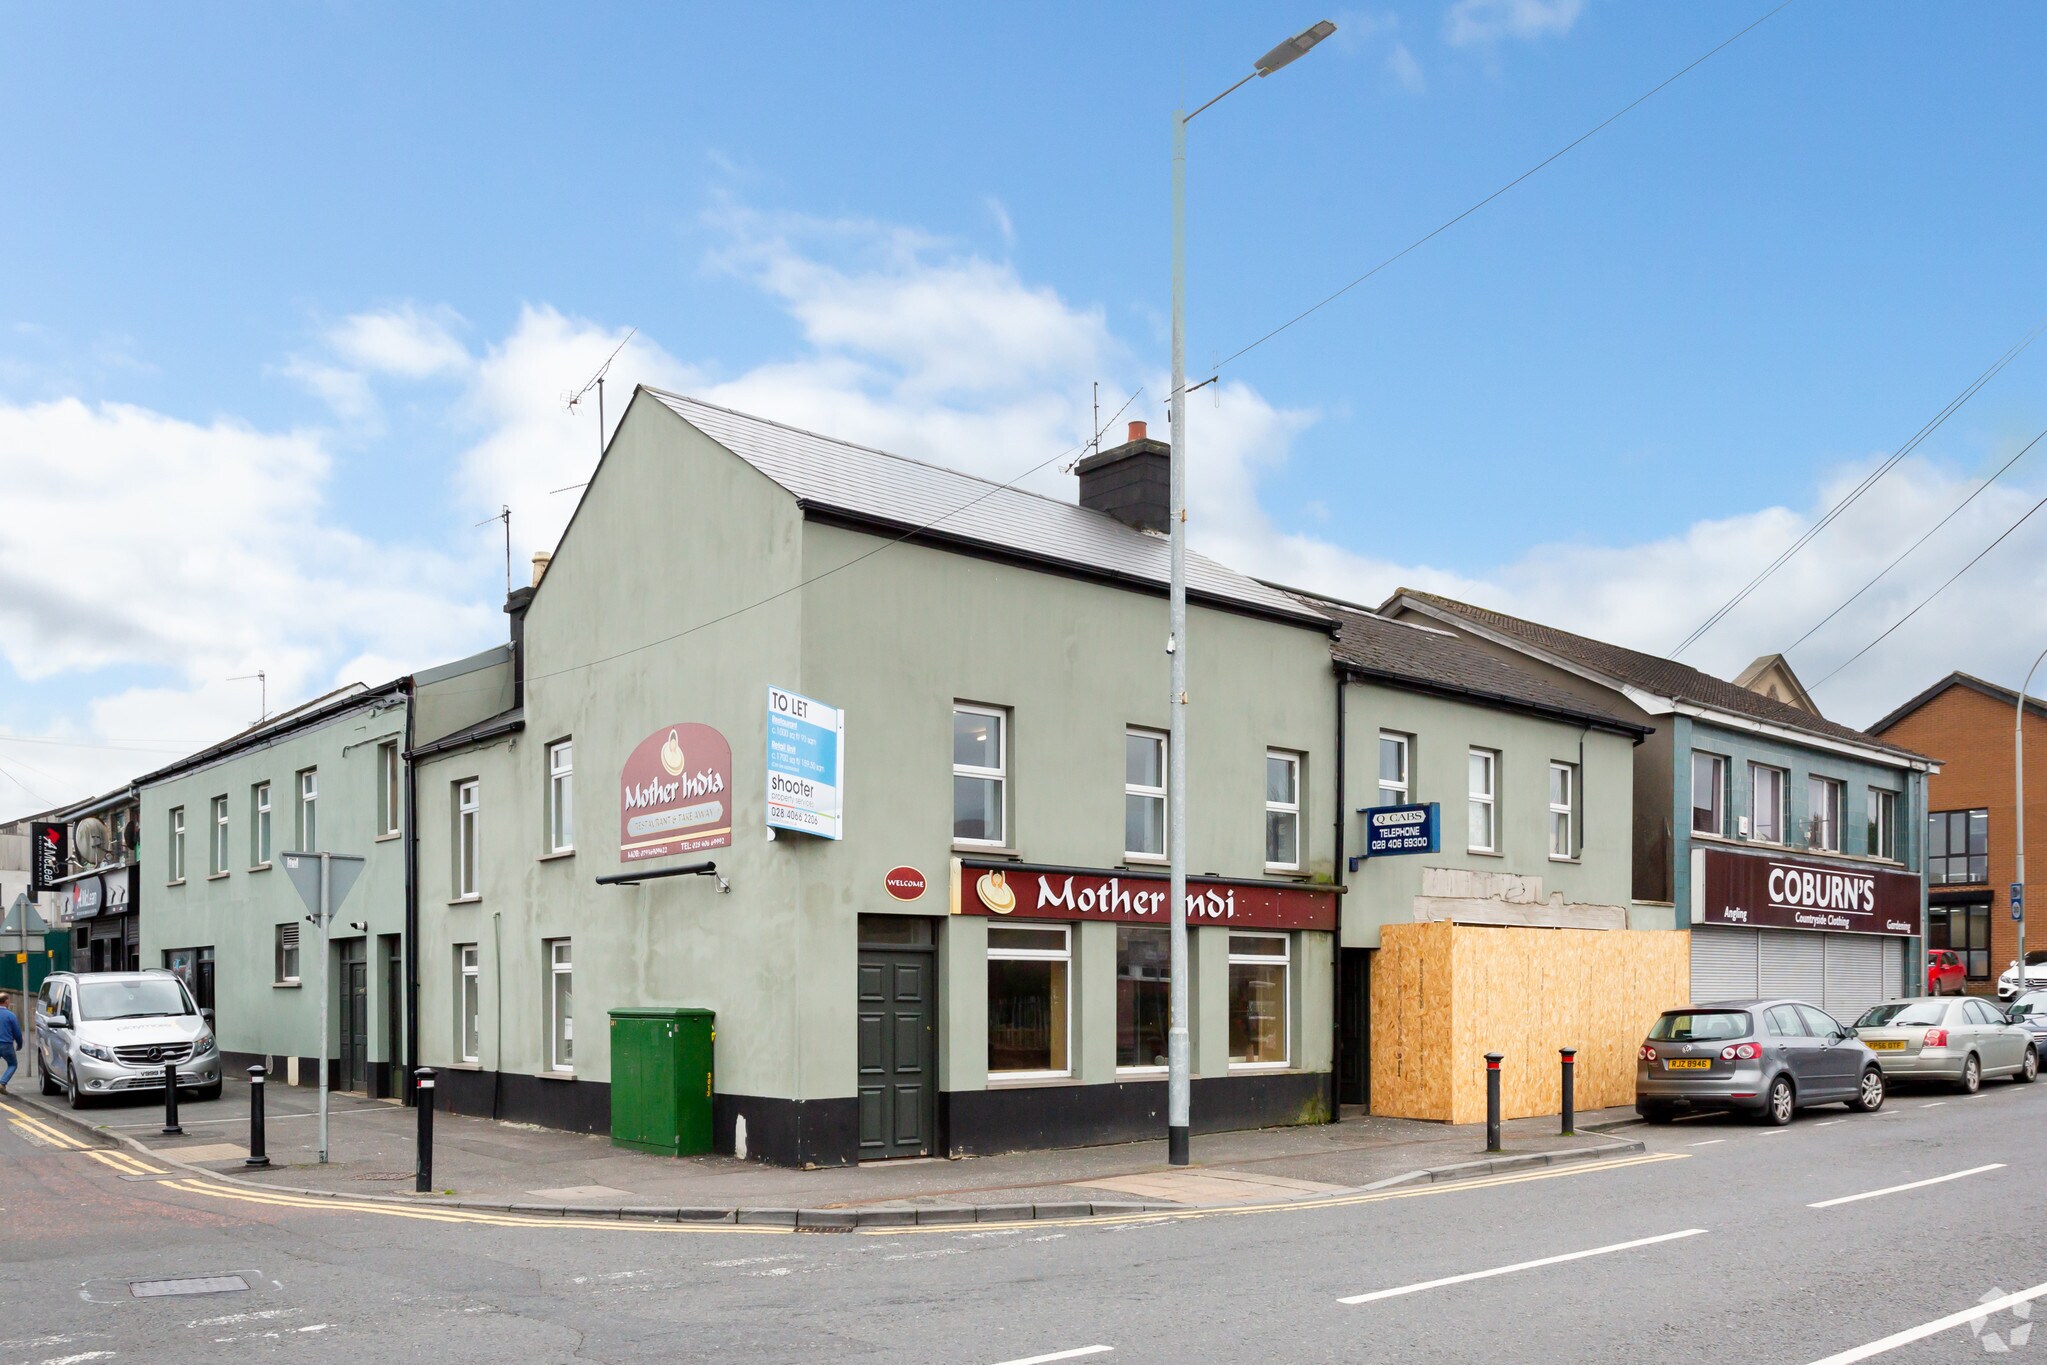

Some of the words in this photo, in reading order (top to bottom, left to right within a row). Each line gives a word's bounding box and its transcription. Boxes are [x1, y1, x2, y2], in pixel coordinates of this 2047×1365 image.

[772, 692, 788, 712] TO
[792, 698, 808, 718] LET
[625, 776, 680, 811] Mother
[682, 768, 725, 800] India
[772, 774, 814, 798] shooter
[771, 792, 794, 805] property
[678, 812, 693, 822] TAKE
[694, 808, 713, 819] AWAY
[772, 806, 785, 818] 028
[786, 810, 802, 822] 4066
[804, 813, 819, 826] 2206
[1376, 815, 1386, 825] Q
[1390, 812, 1422, 822] CABS
[1380, 826, 1420, 838] TELEPHONE
[680, 842, 692, 850] TEL:
[1372, 840, 1386, 850] 028
[1388, 839, 1402, 848] 406
[1404, 837, 1428, 848] 69300
[887, 879, 924, 888] WELCOME
[1768, 868, 1874, 912] COBURN'S
[1037, 875, 1166, 915] Mother
[1185, 888, 1234, 919] ndi
[1724, 906, 1748, 922] Angling
[1795, 912, 1827, 928] Countryside
[1828, 914, 1850, 930] Clothing
[1886, 919, 1912, 934] Gardening
[1672, 1060, 1686, 1068] RJZ
[1687, 1060, 1708, 1068] 8946
